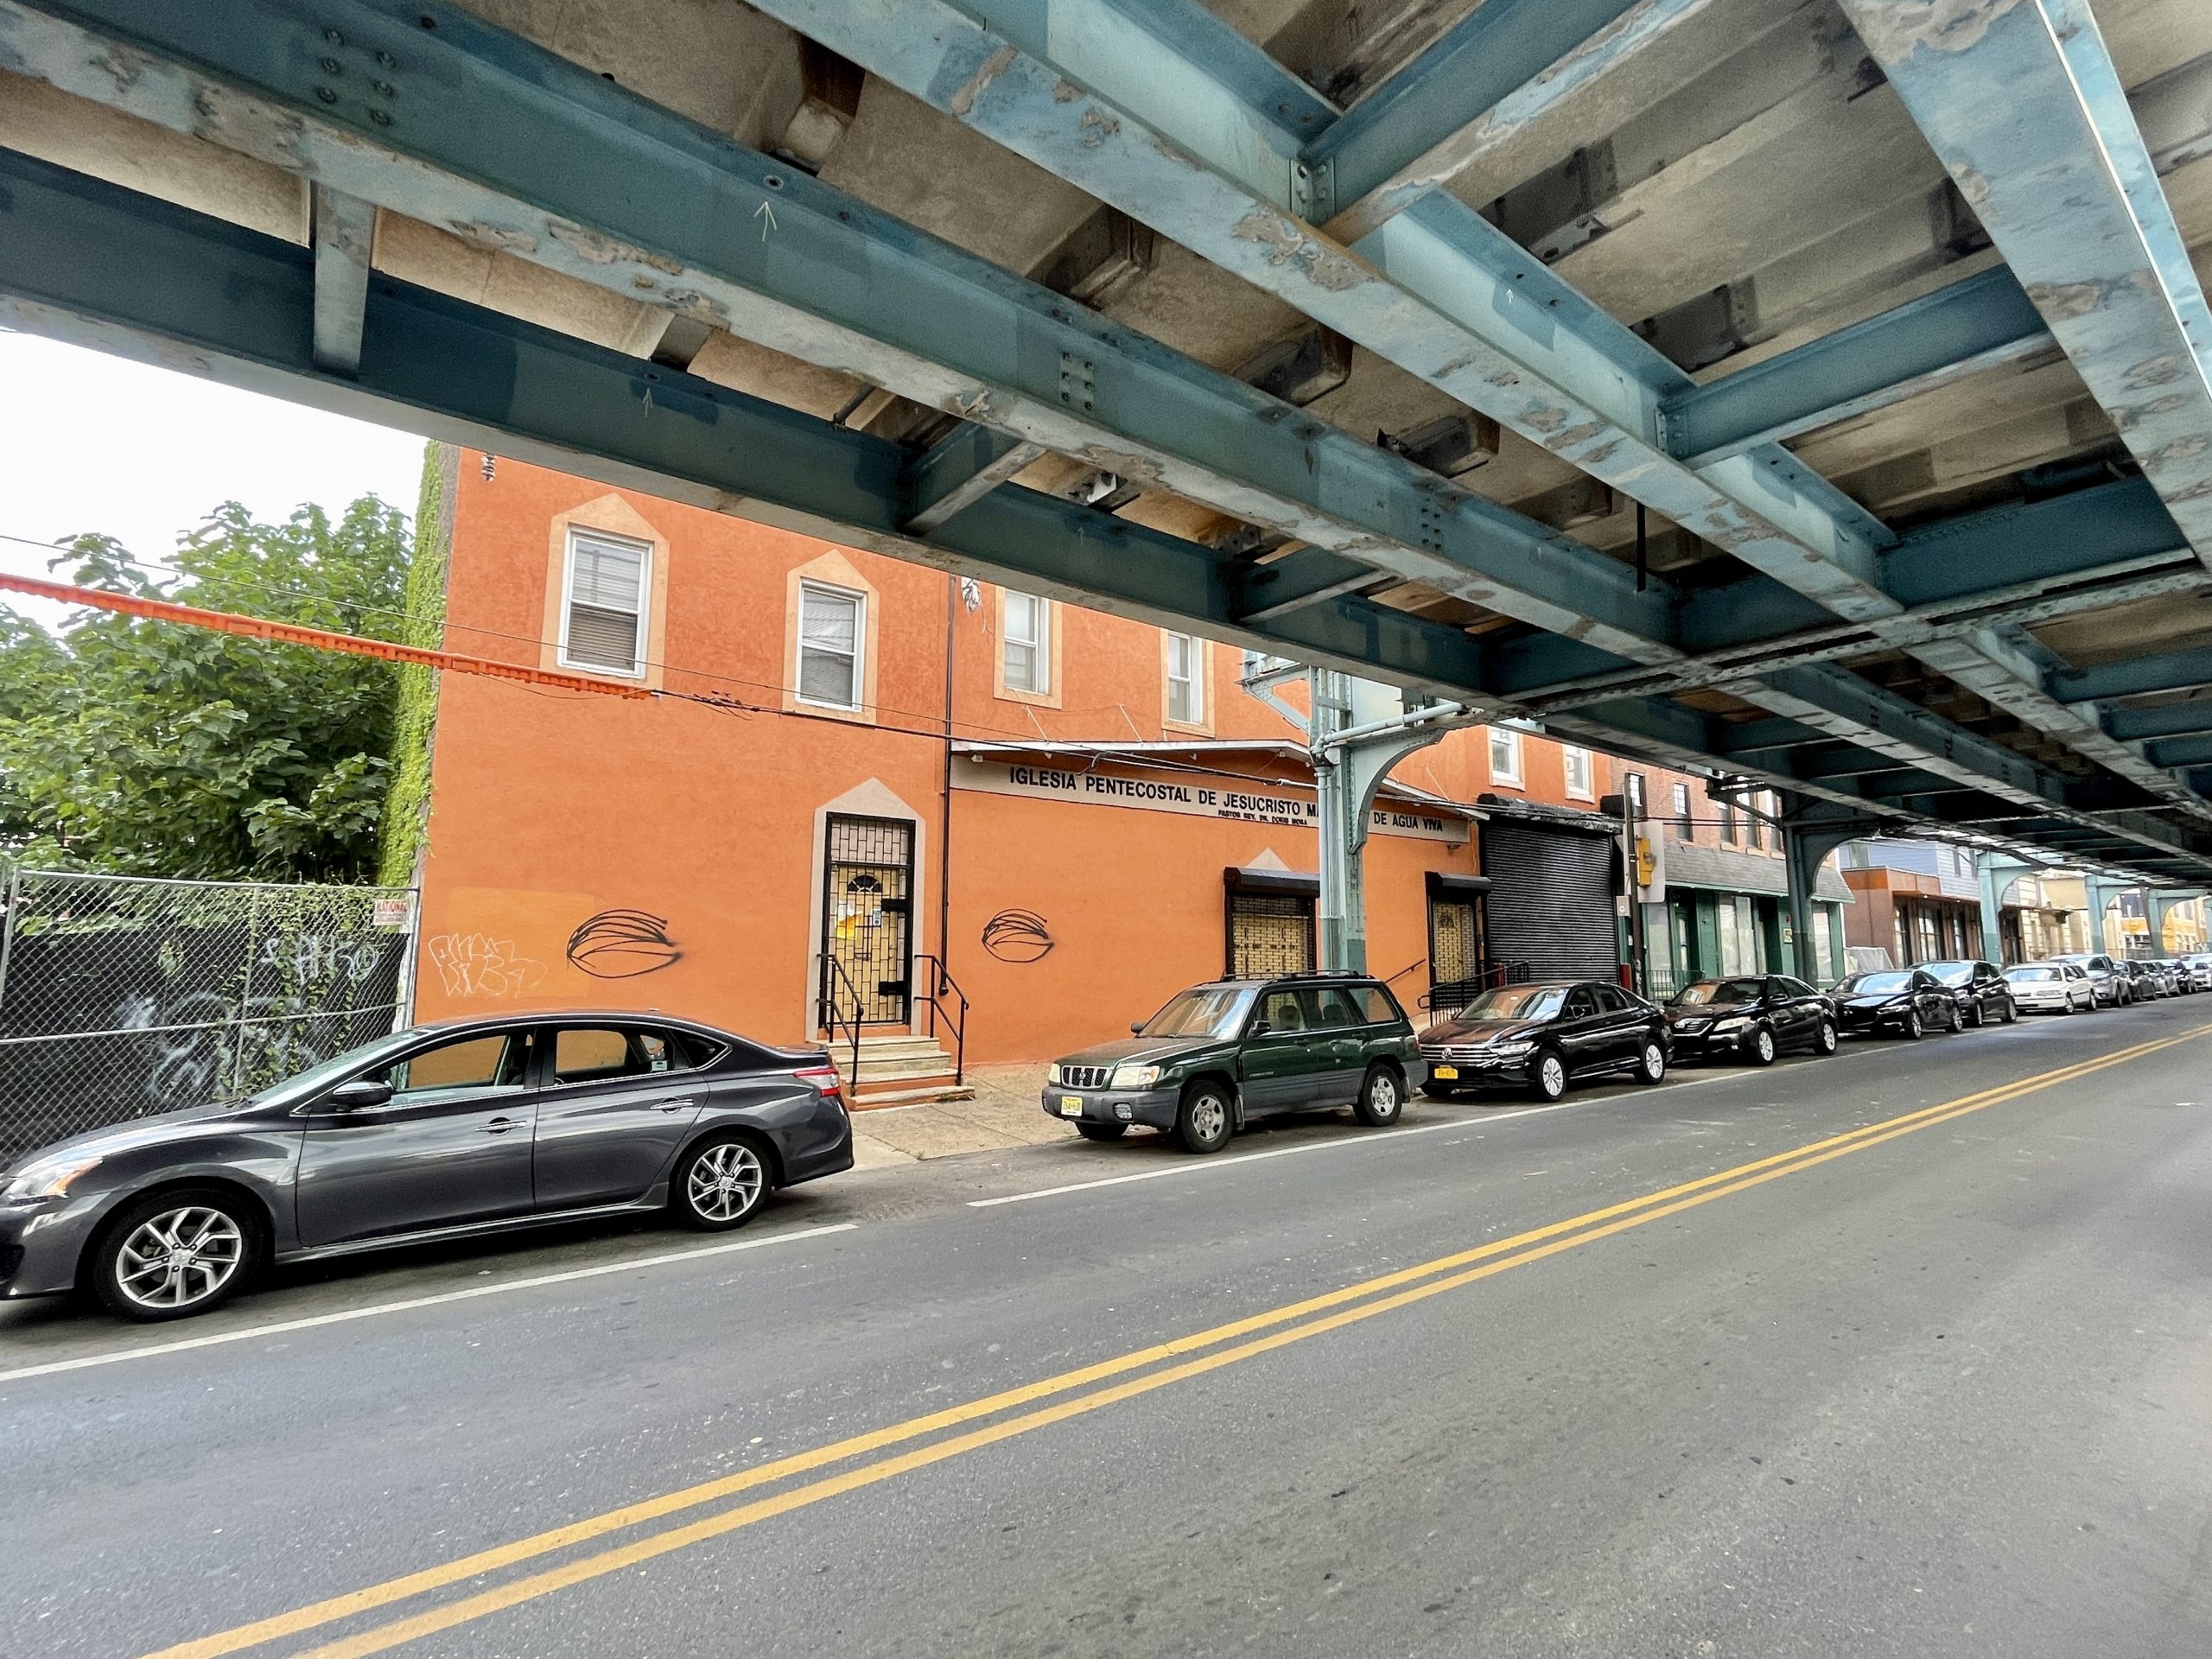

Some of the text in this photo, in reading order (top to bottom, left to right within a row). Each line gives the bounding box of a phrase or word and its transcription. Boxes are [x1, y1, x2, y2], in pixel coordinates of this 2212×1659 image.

[1009, 766, 1077, 790] IGLESIA
[1085, 776, 1192, 803] PENTECOSTAL
[1198, 790, 1217, 805] DE
[1224, 793, 1300, 815] JESUCRISTO
[1373, 811, 1388, 825] DE
[1392, 814, 1419, 830] AGUA
[1422, 817, 1444, 832] VIVA
[1217, 810, 1241, 818] PASTOR
